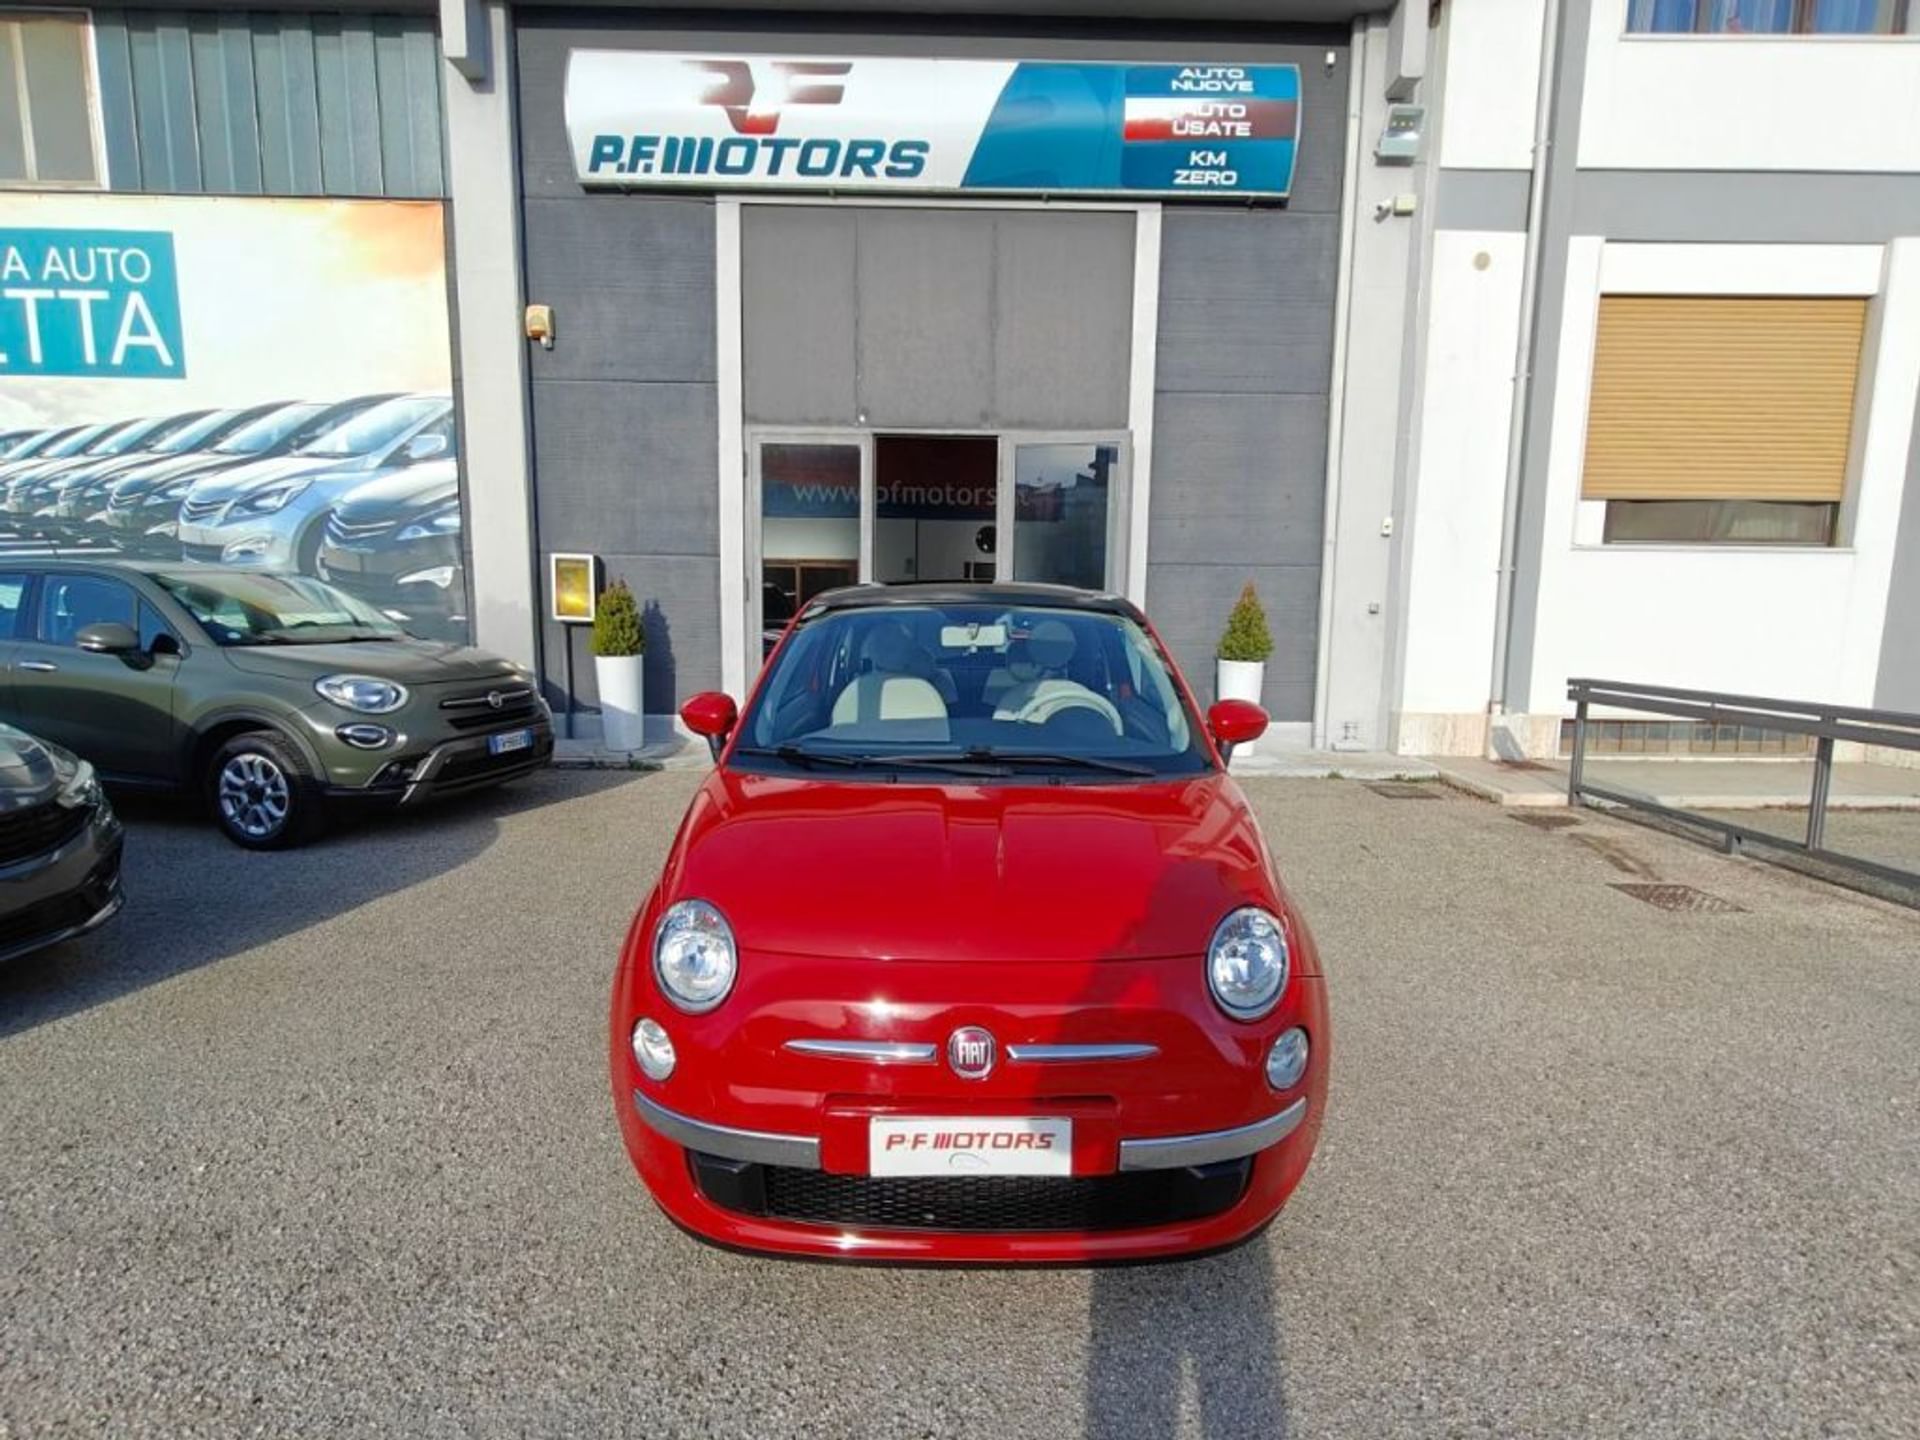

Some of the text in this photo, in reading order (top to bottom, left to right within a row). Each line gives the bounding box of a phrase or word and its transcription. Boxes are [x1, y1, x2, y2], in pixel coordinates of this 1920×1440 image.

[1178, 67, 1245, 80] AUTO
[1171, 80, 1254, 92] NUOVE
[1171, 120, 1252, 137] USATE
[1189, 150, 1228, 167] KM
[1172, 169, 1237, 186] ZERO
[42, 246, 151, 284] AUTO
[0, 288, 175, 367] TTA
[958, 1041, 988, 1065] FIAT
[932, 1131, 1057, 1150] MOTORS
